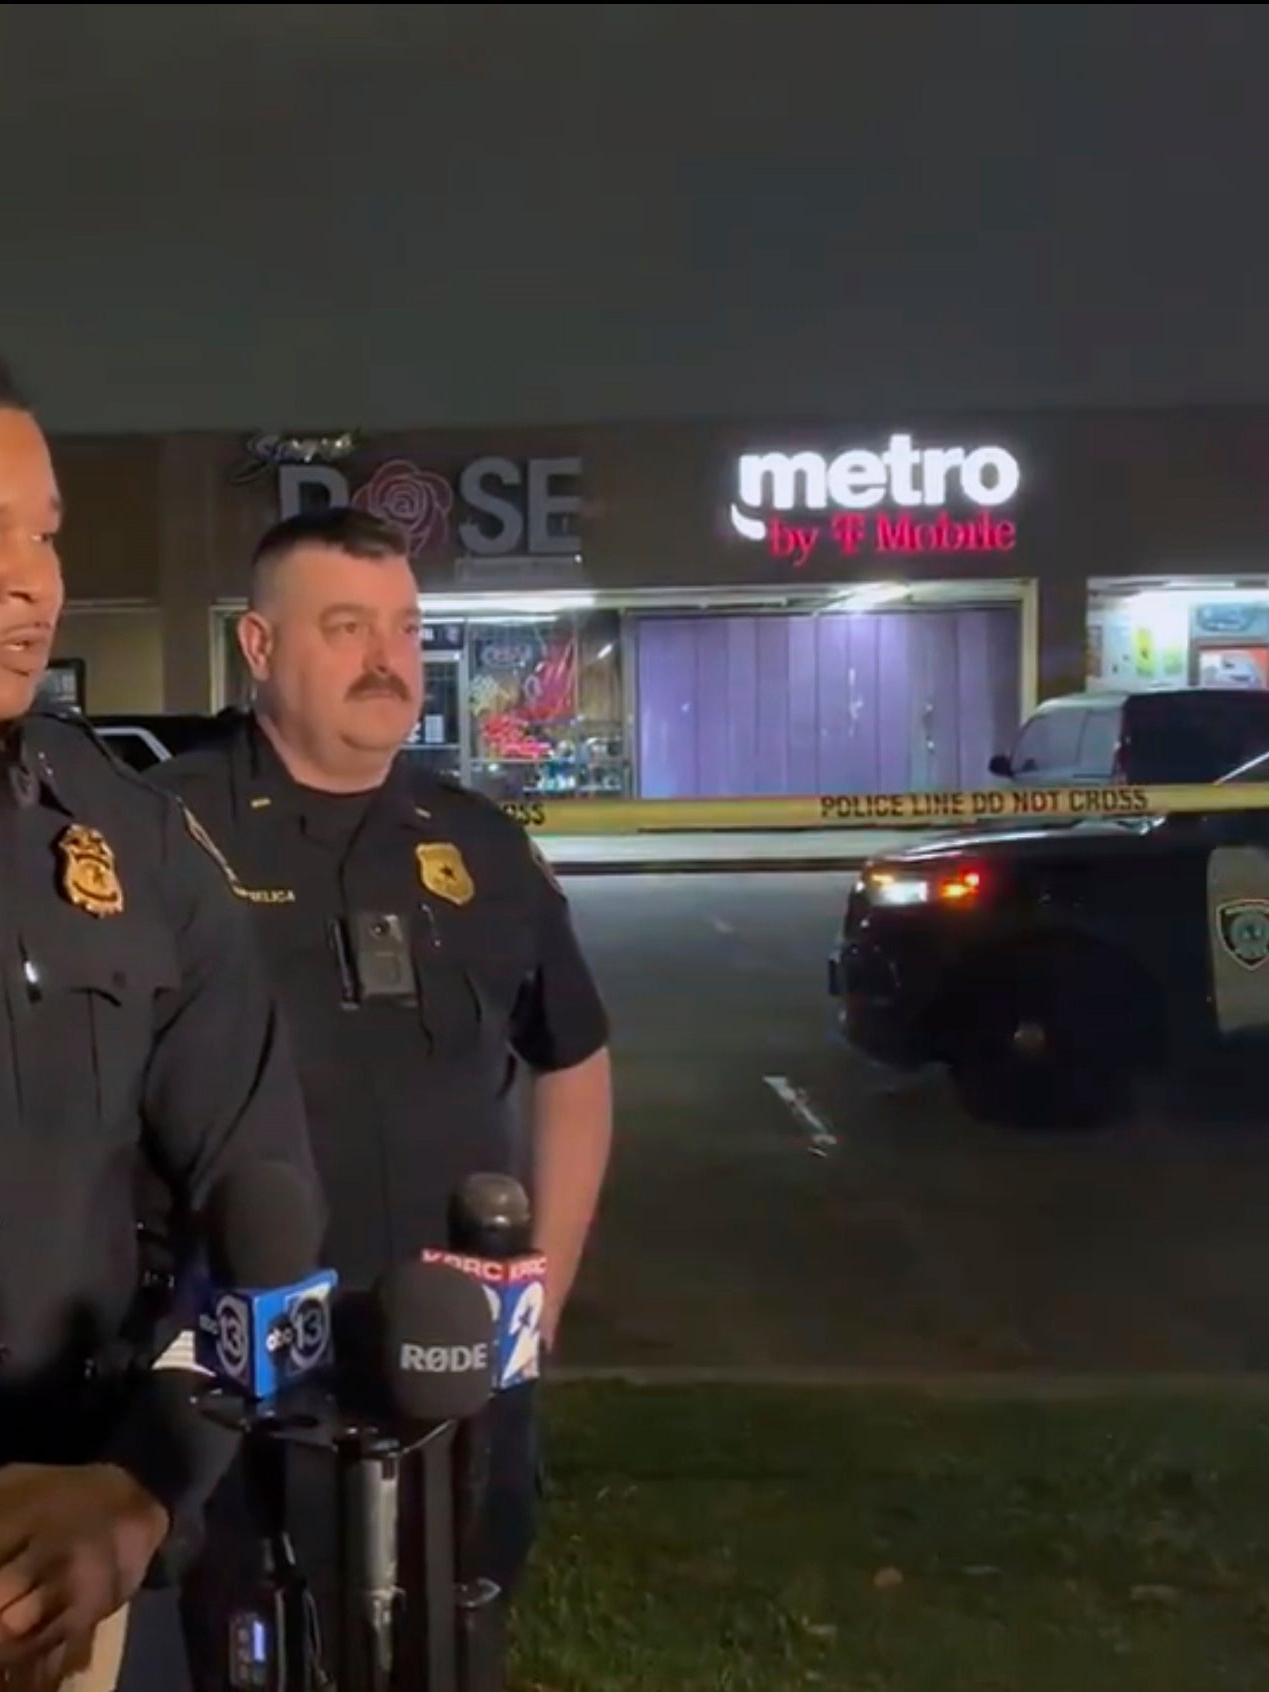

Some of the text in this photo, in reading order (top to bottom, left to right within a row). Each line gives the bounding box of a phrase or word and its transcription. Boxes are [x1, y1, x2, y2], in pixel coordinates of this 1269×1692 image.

[735, 433, 1021, 510] metro
[769, 513, 820, 567] by
[820, 787, 1149, 818] POLICE LINE DO NOT CROSS
[399, 1341, 489, 1373] RØDE
